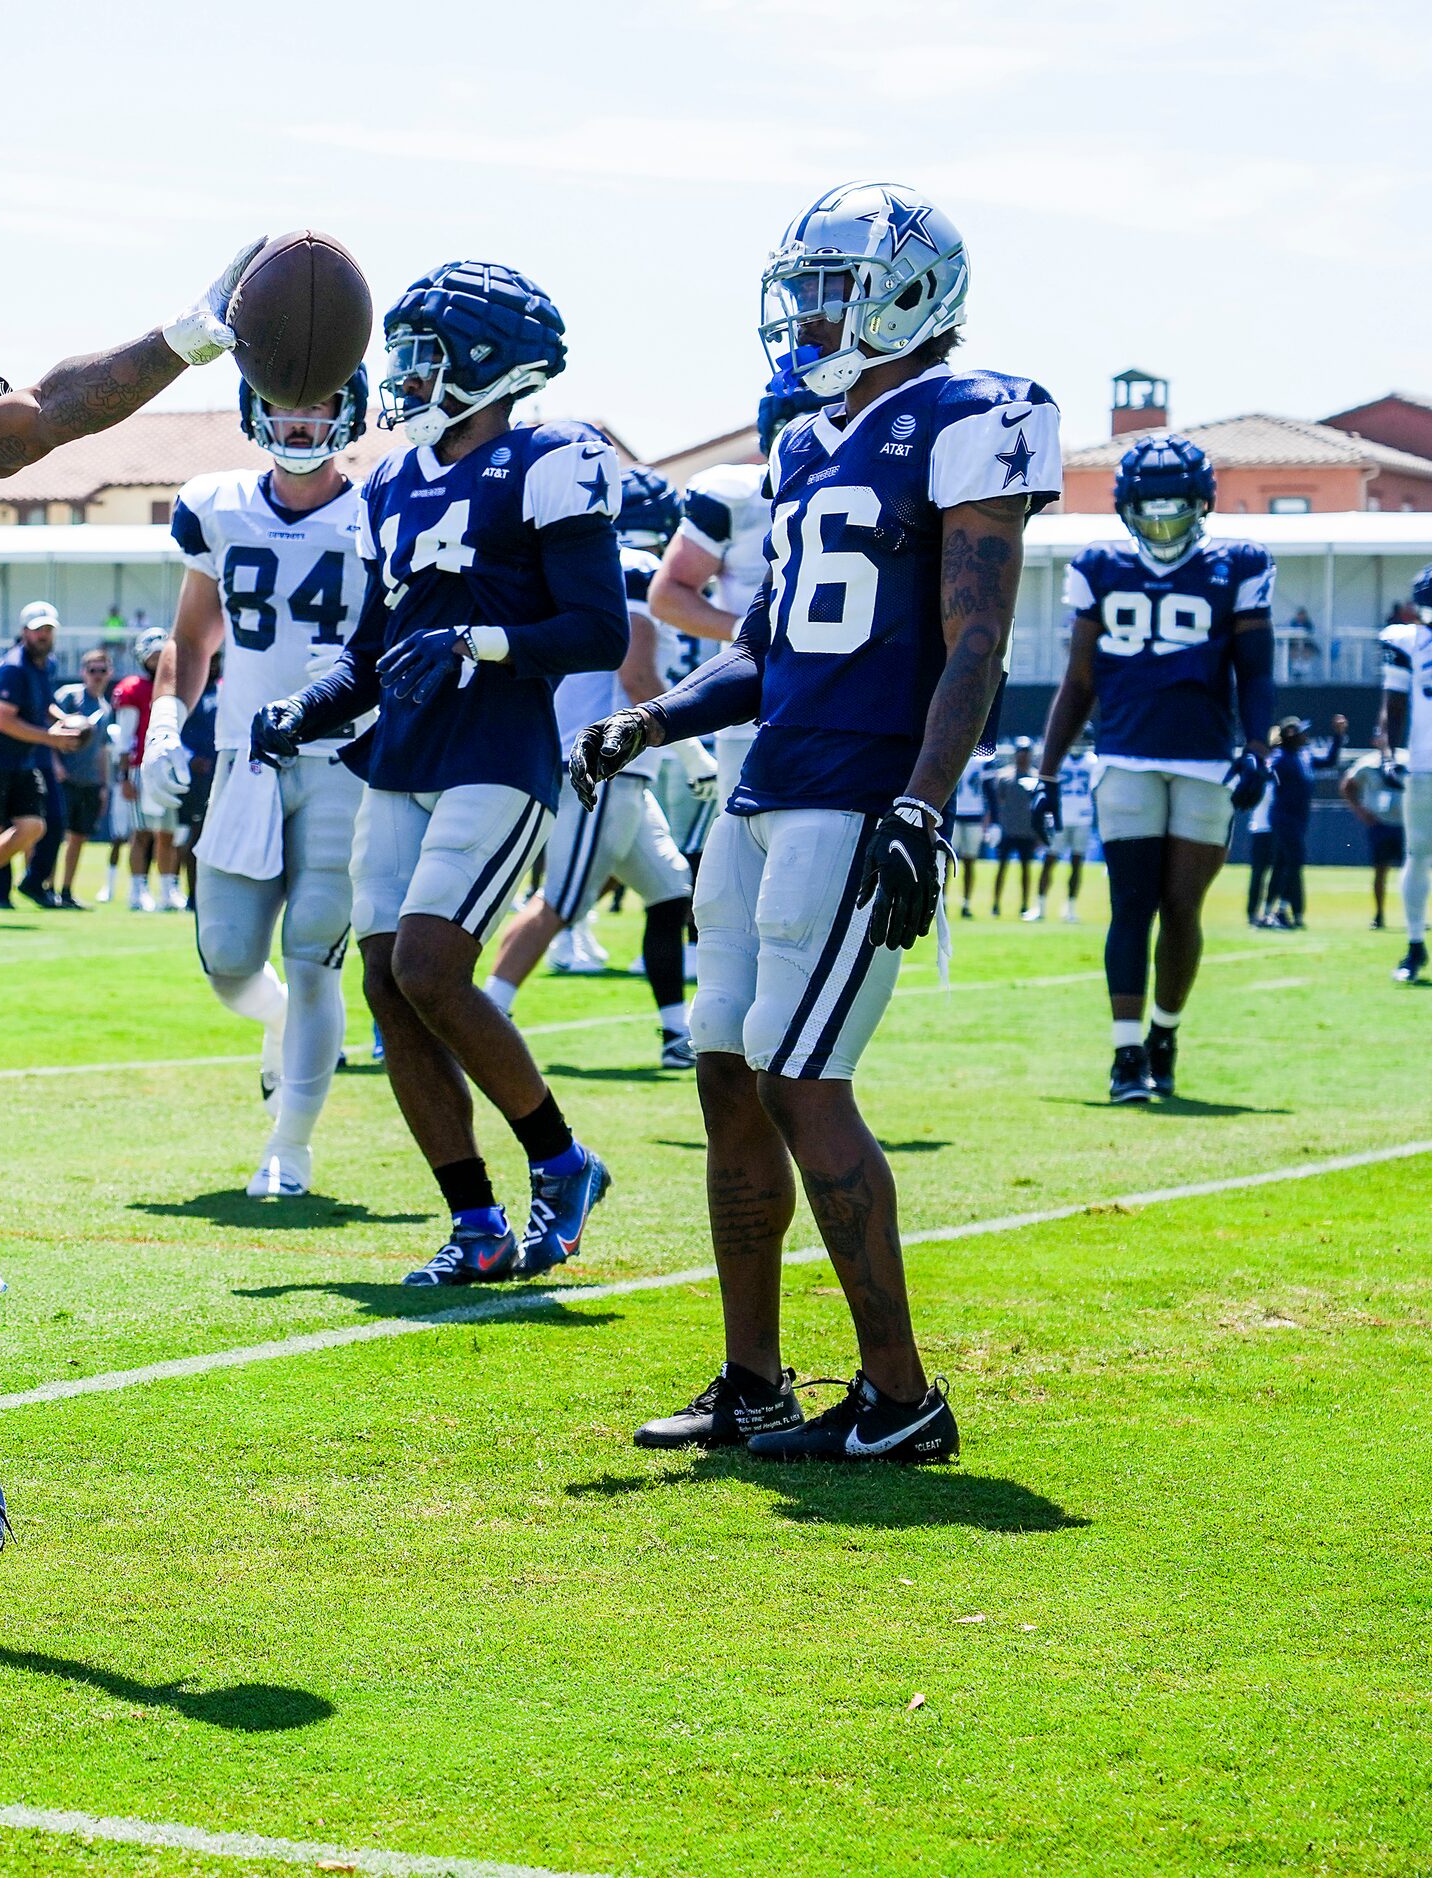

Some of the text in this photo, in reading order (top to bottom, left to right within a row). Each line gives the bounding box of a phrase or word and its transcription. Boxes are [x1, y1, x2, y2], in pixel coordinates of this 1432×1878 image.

[880, 442, 913, 457] AT&T
[482, 467, 510, 479] AT&T
[224, 546, 348, 651] 84
[1098, 591, 1212, 657] 99
[915, 1438, 942, 1451] "CLEAT"
